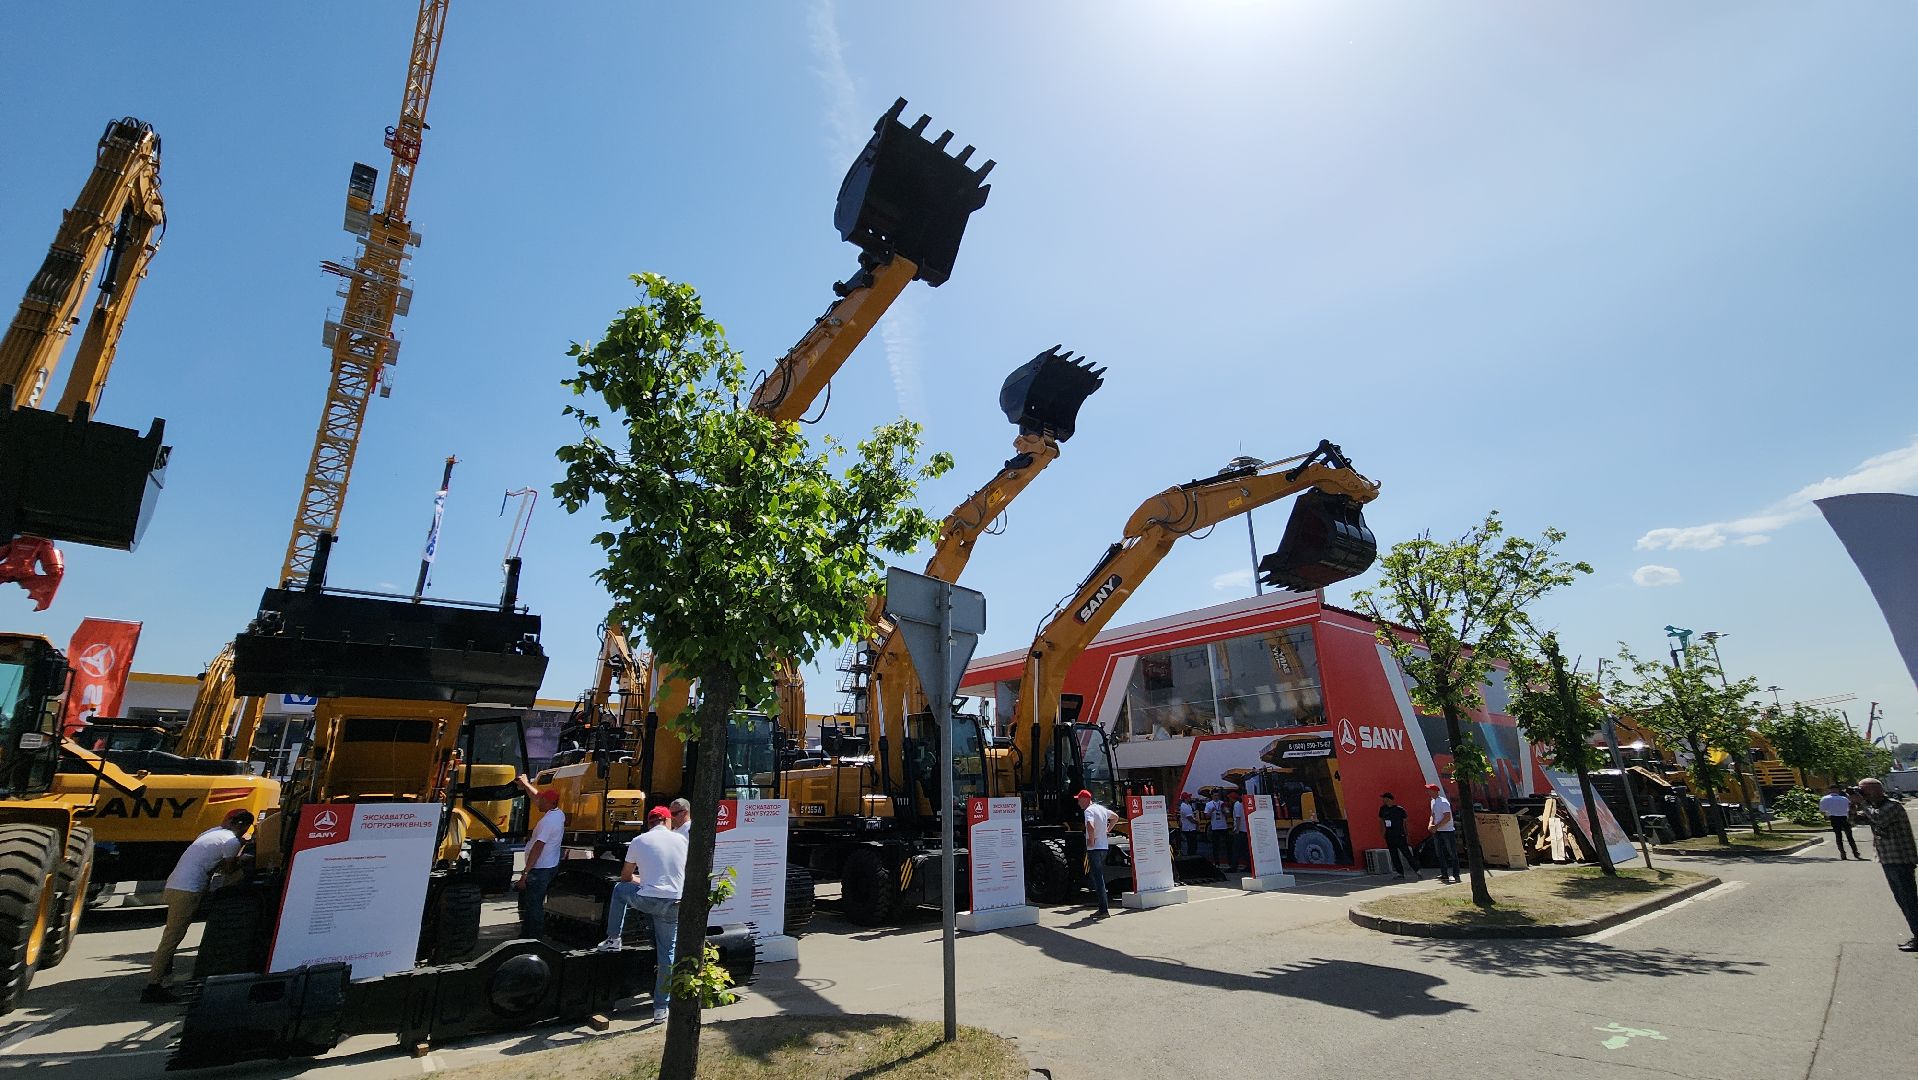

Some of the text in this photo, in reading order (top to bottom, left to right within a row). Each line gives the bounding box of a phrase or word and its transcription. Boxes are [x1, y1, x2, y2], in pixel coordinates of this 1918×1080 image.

[1080, 577, 1114, 622] SANY
[1359, 726, 1403, 750] SANY
[76, 797, 198, 818] ANY
[362, 813, 417, 821] ЭКСКАВАТОР-
